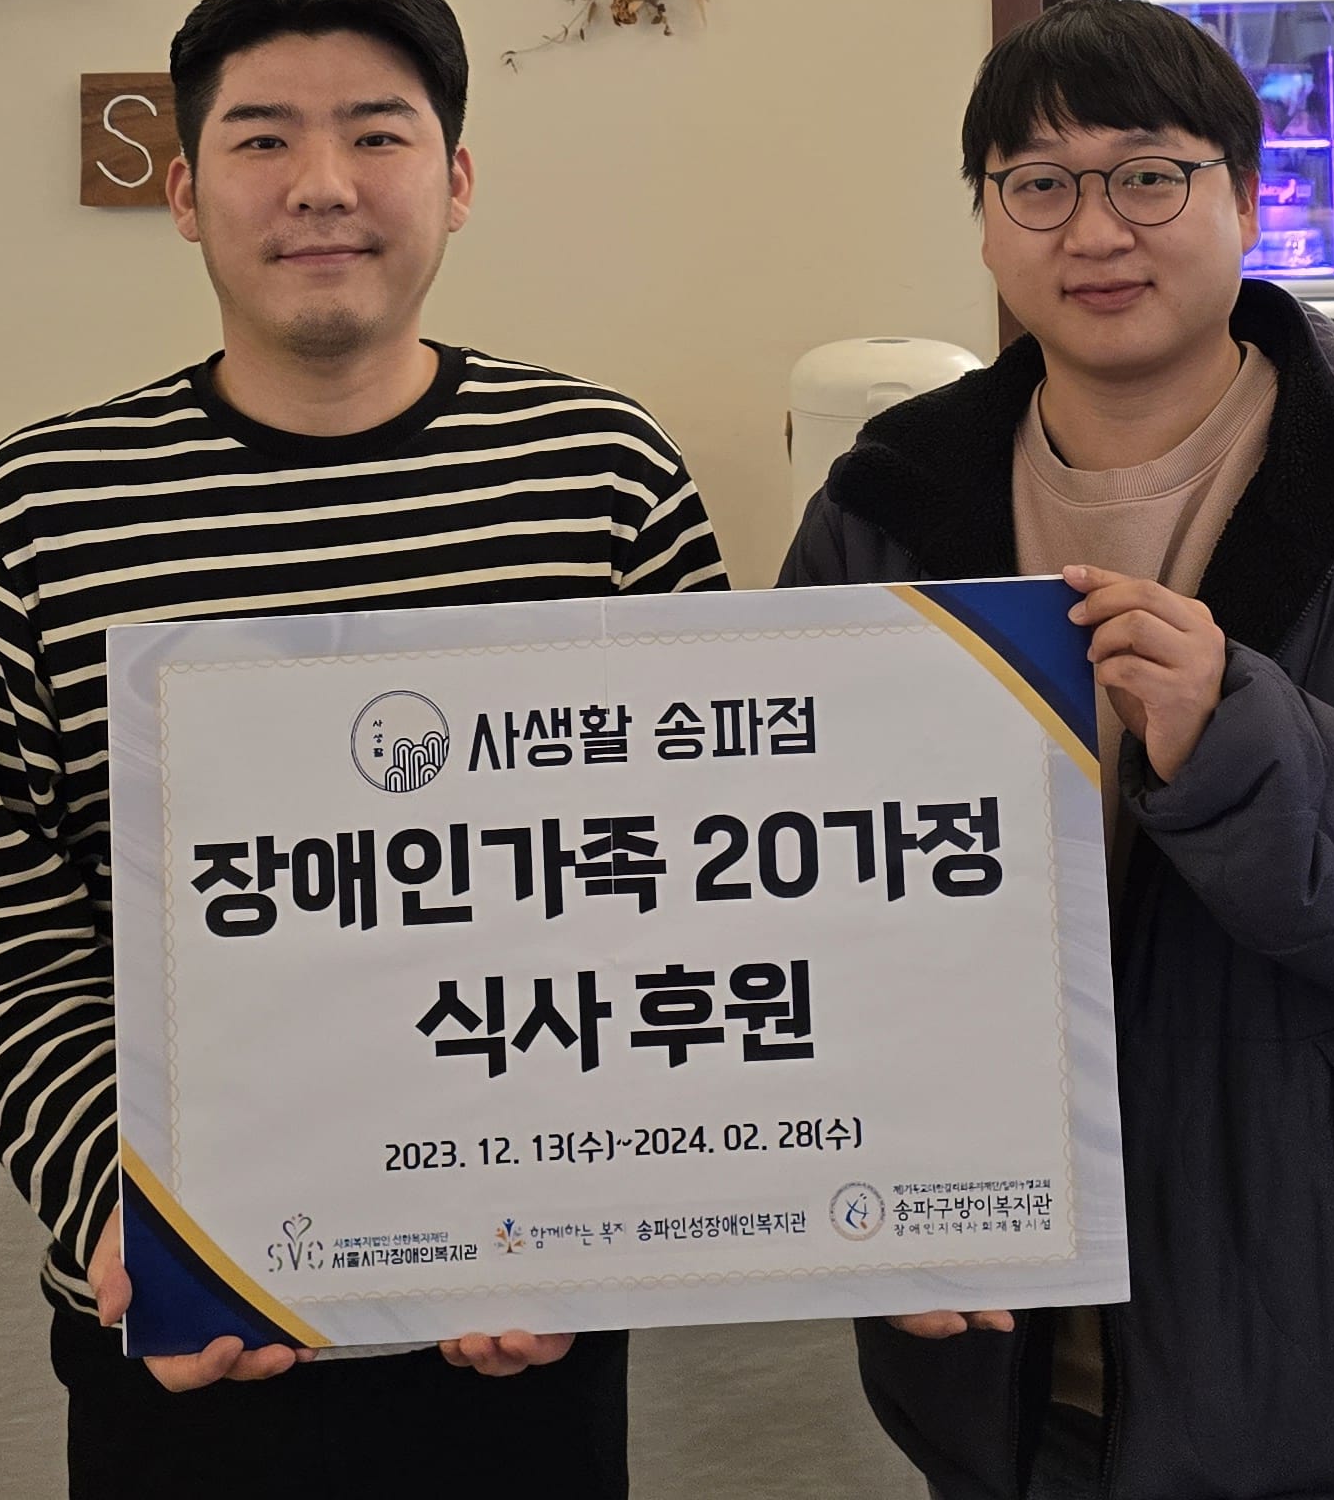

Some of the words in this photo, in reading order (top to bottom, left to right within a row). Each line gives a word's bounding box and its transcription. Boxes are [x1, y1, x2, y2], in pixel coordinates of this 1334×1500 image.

[96, 94, 158, 188] S
[468, 702, 634, 773] 사생활
[653, 697, 817, 762] 송파점
[190, 815, 667, 938] 장애인가족
[693, 796, 1005, 902] 20가정
[415, 969, 613, 1079] 식사
[629, 959, 816, 1069] 후원
[385, 1140, 466, 1171] 2023.
[478, 1136, 520, 1165] 12.
[723, 1123, 768, 1151] 02.
[778, 1117, 863, 1151] 28(수)
[530, 1224, 595, 1249] 함께하는
[635, 1210, 807, 1242] 송파인성장애인복지관
[892, 1193, 1053, 1222] 송파구방이복지관
[331, 1243, 478, 1269] 서울시각장애인복지관
